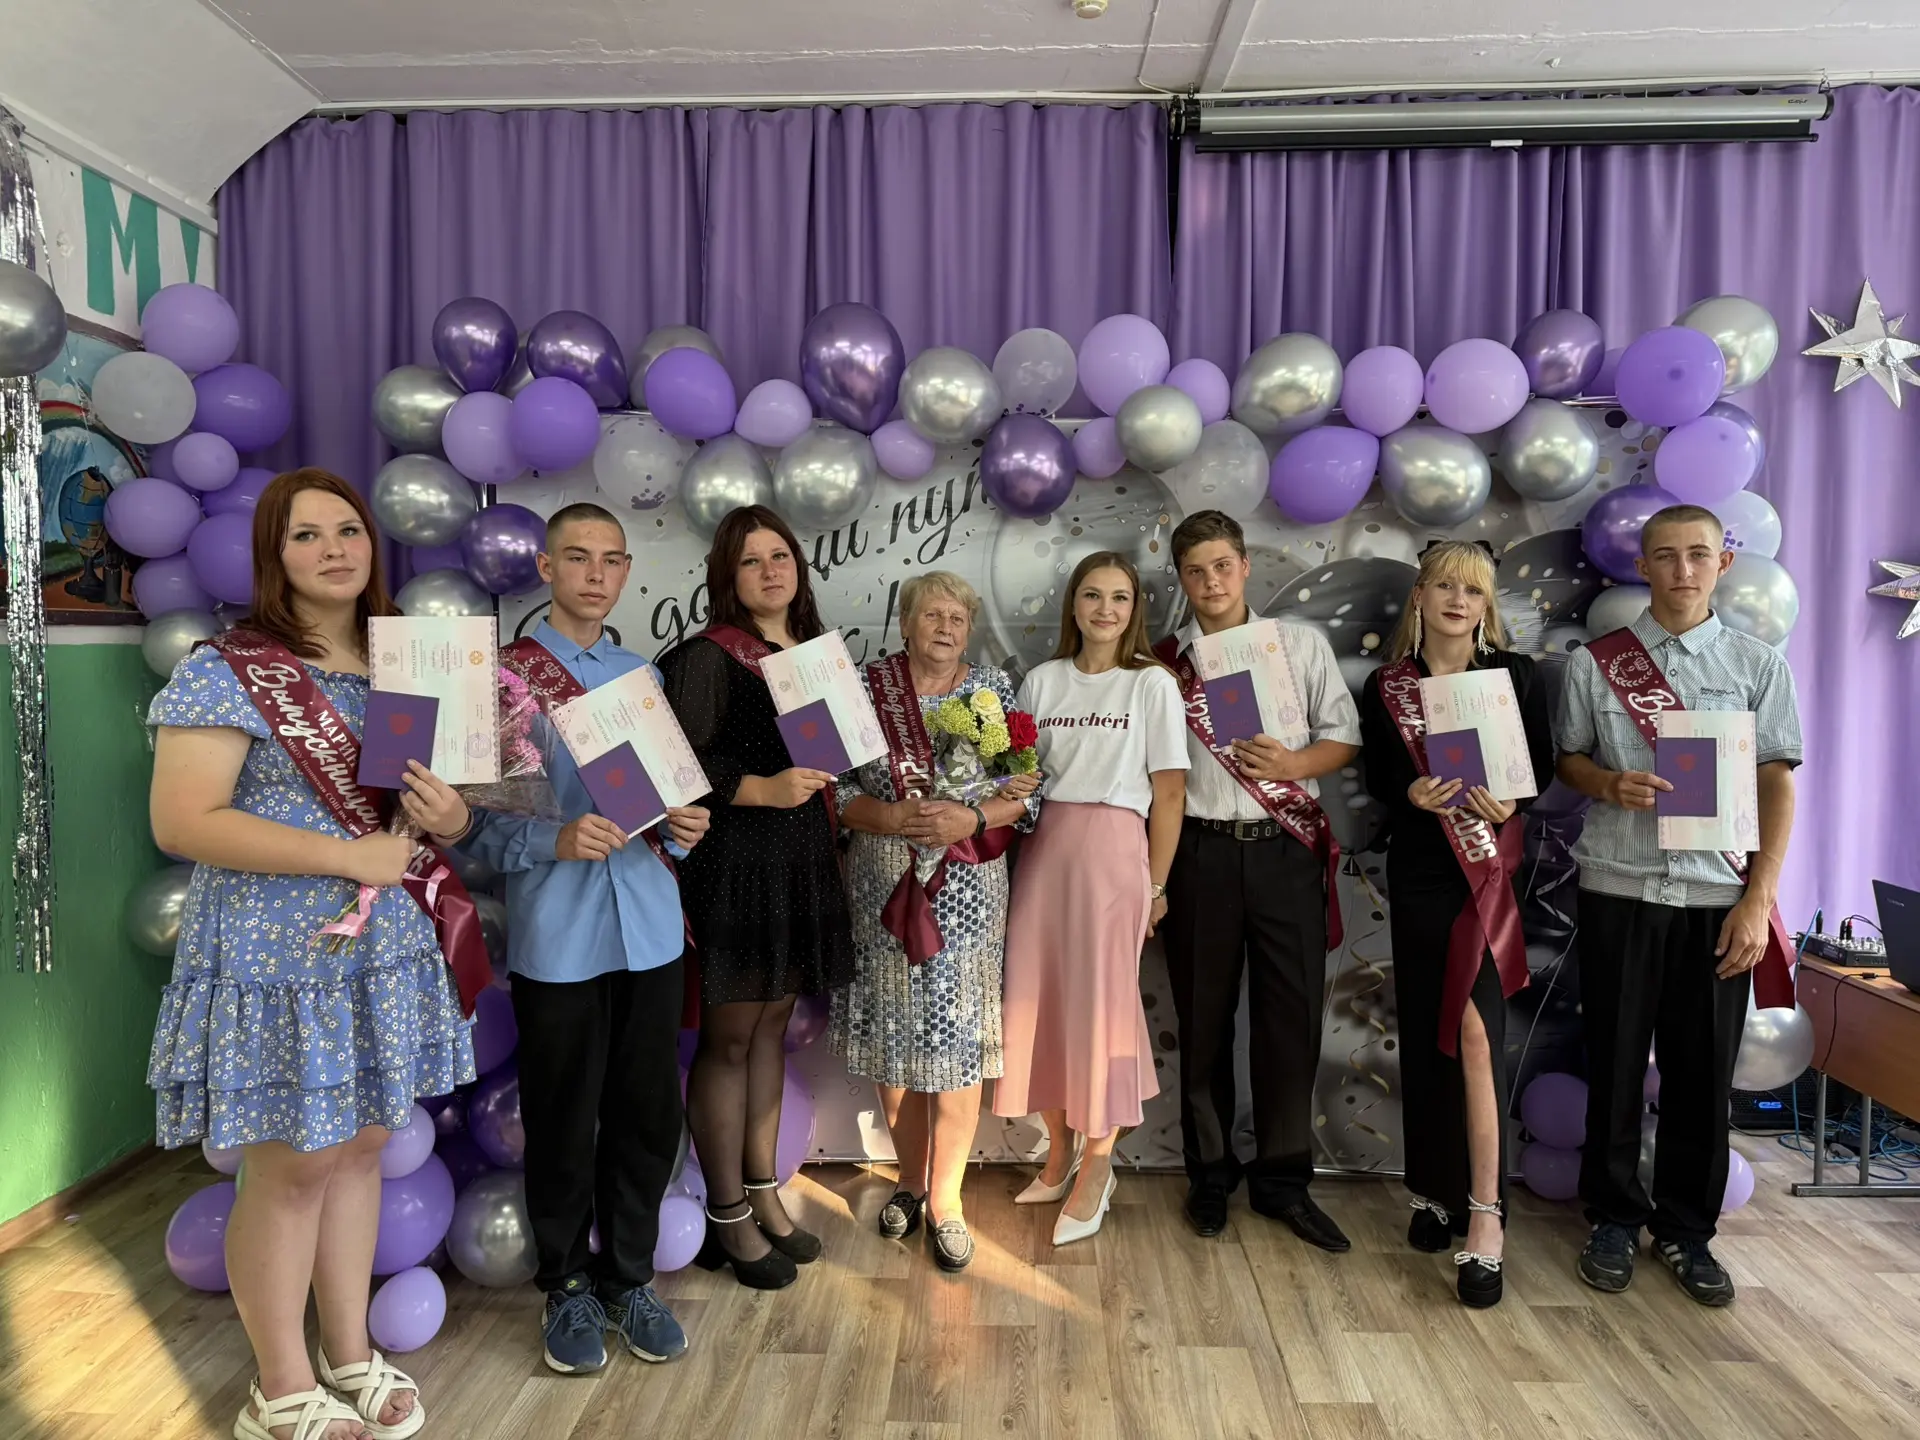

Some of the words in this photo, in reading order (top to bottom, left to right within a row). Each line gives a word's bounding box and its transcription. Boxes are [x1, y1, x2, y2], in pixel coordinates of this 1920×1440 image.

[1625, 664, 1636, 672] 9
[879, 659, 914, 761] уководитель
[1038, 716, 1076, 729] mon
[1078, 712, 1130, 730] chéri
[247, 661, 380, 823] Выпускница
[314, 709, 358, 768] МАРИН
[908, 715, 926, 760] ВАСИЛЬЕВНА
[284, 737, 304, 760] МБОУ
[324, 791, 342, 811] СОШ
[1250, 786, 1263, 801] СОШ
[1447, 811, 1498, 864] 2026
